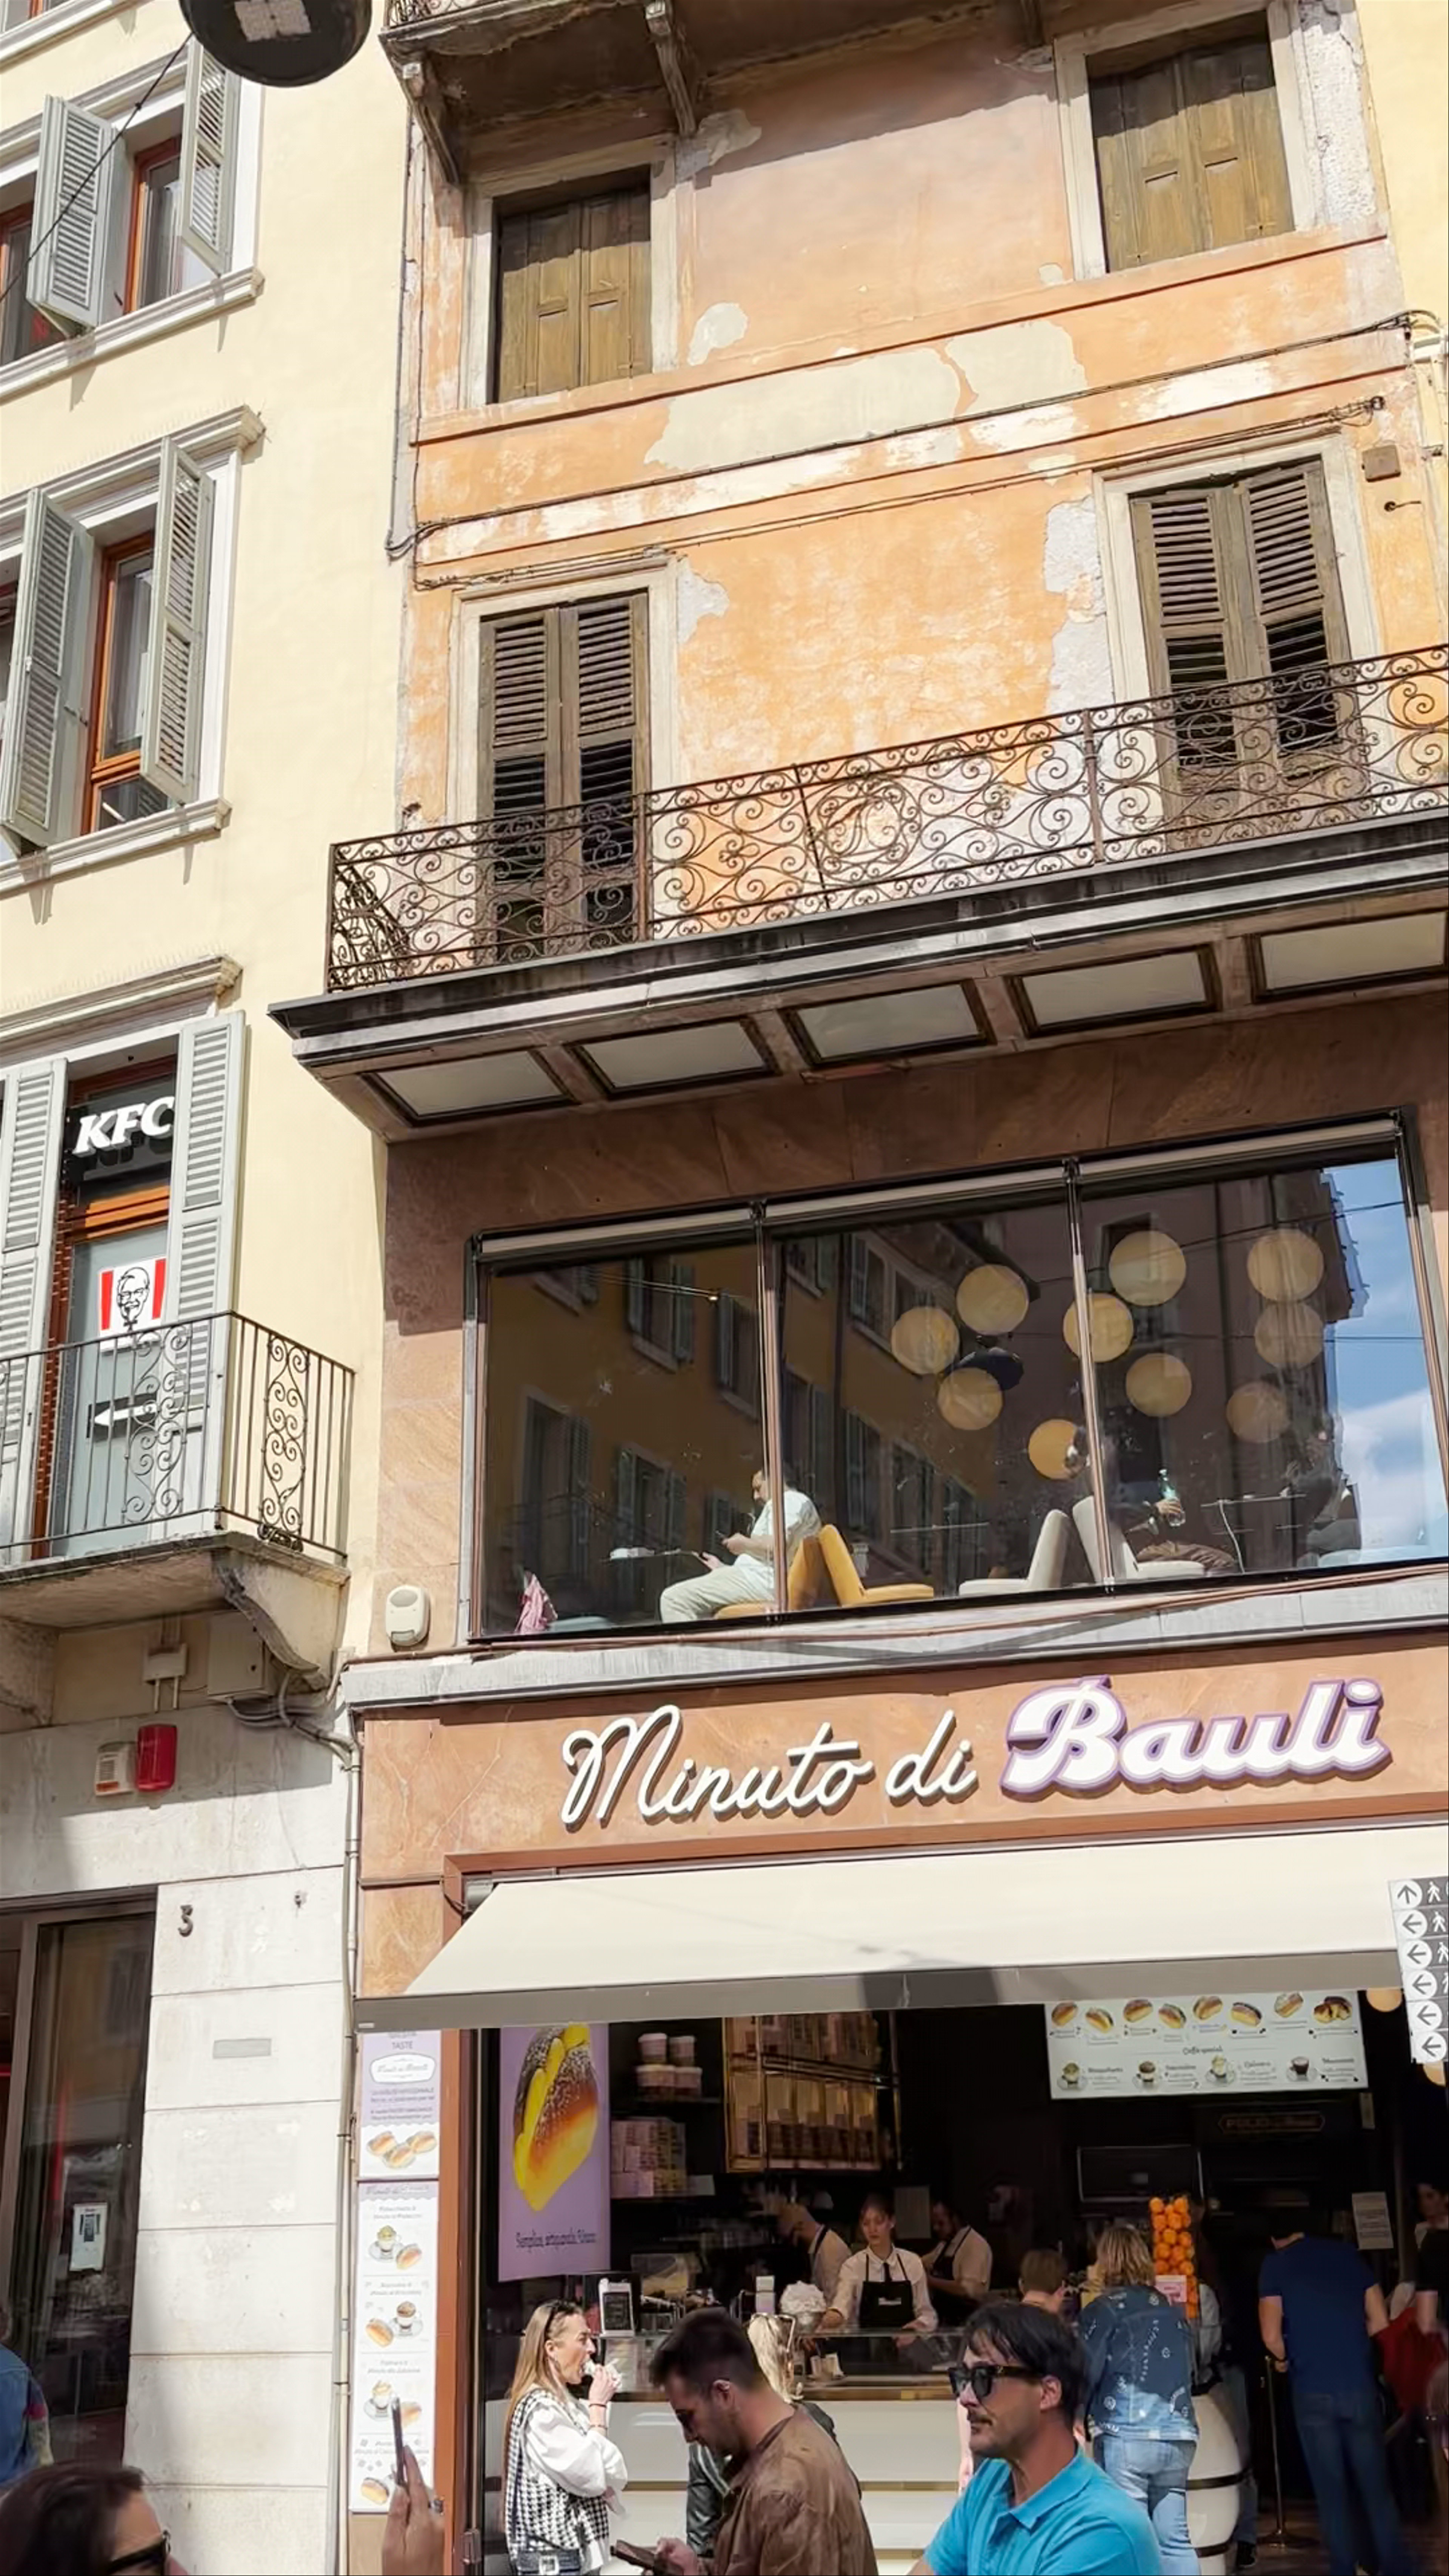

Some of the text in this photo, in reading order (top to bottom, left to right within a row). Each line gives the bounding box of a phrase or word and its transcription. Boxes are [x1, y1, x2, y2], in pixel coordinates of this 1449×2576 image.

[72, 1096, 175, 1157] KFC
[561, 1675, 1392, 1829] Minuto di Bauli
[177, 1904, 193, 1937] 3
[392, 2041, 413, 2050] TASTE
